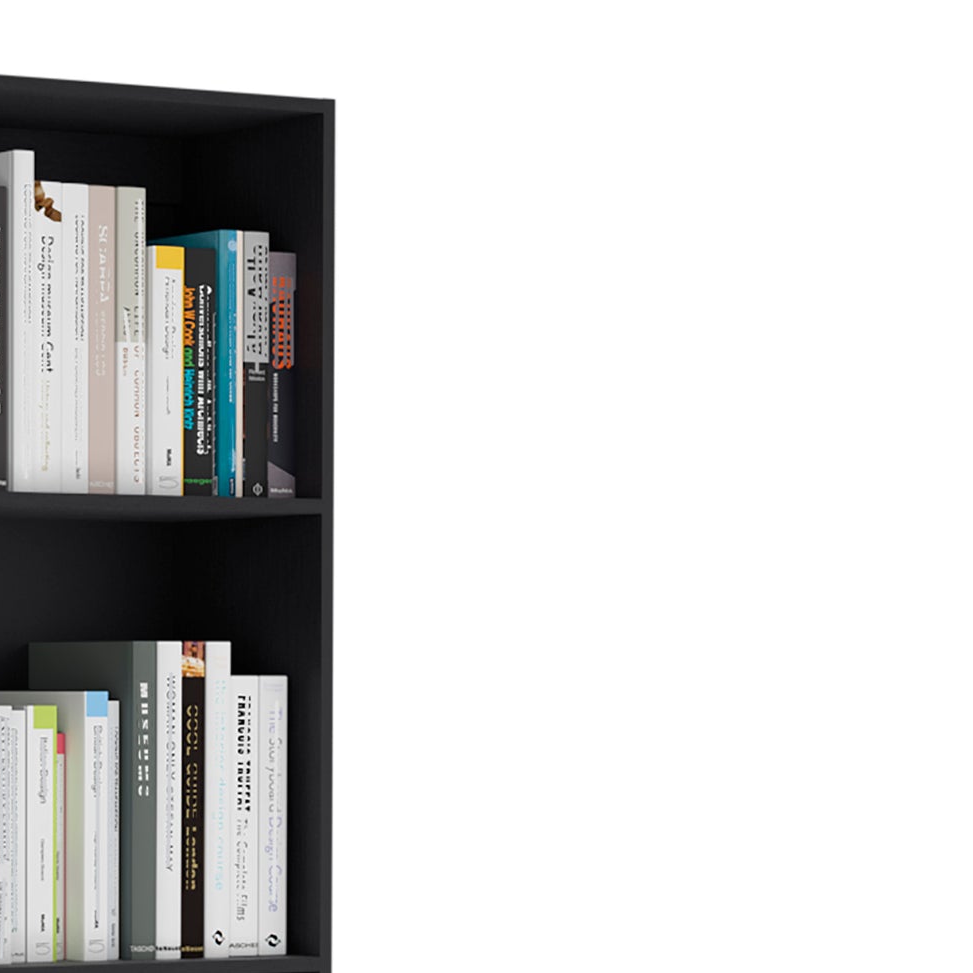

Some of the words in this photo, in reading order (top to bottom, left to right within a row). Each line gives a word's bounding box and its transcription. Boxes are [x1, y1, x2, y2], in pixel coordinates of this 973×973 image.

[38, 236, 55, 280] Design
[40, 284, 54, 338] museum
[197, 284, 213, 368] Conversations
[271, 276, 292, 371] BAUHAUS
[184, 347, 196, 367] and
[197, 370, 213, 395] with
[196, 397, 213, 456] Architects
[186, 705, 199, 757] COOL
[268, 707, 283, 734] The
[186, 763, 199, 819] GUIDE
[264, 737, 283, 814] Storyboard
[185, 826, 200, 891] London
[264, 816, 283, 862] Design
[268, 865, 283, 914] Course
